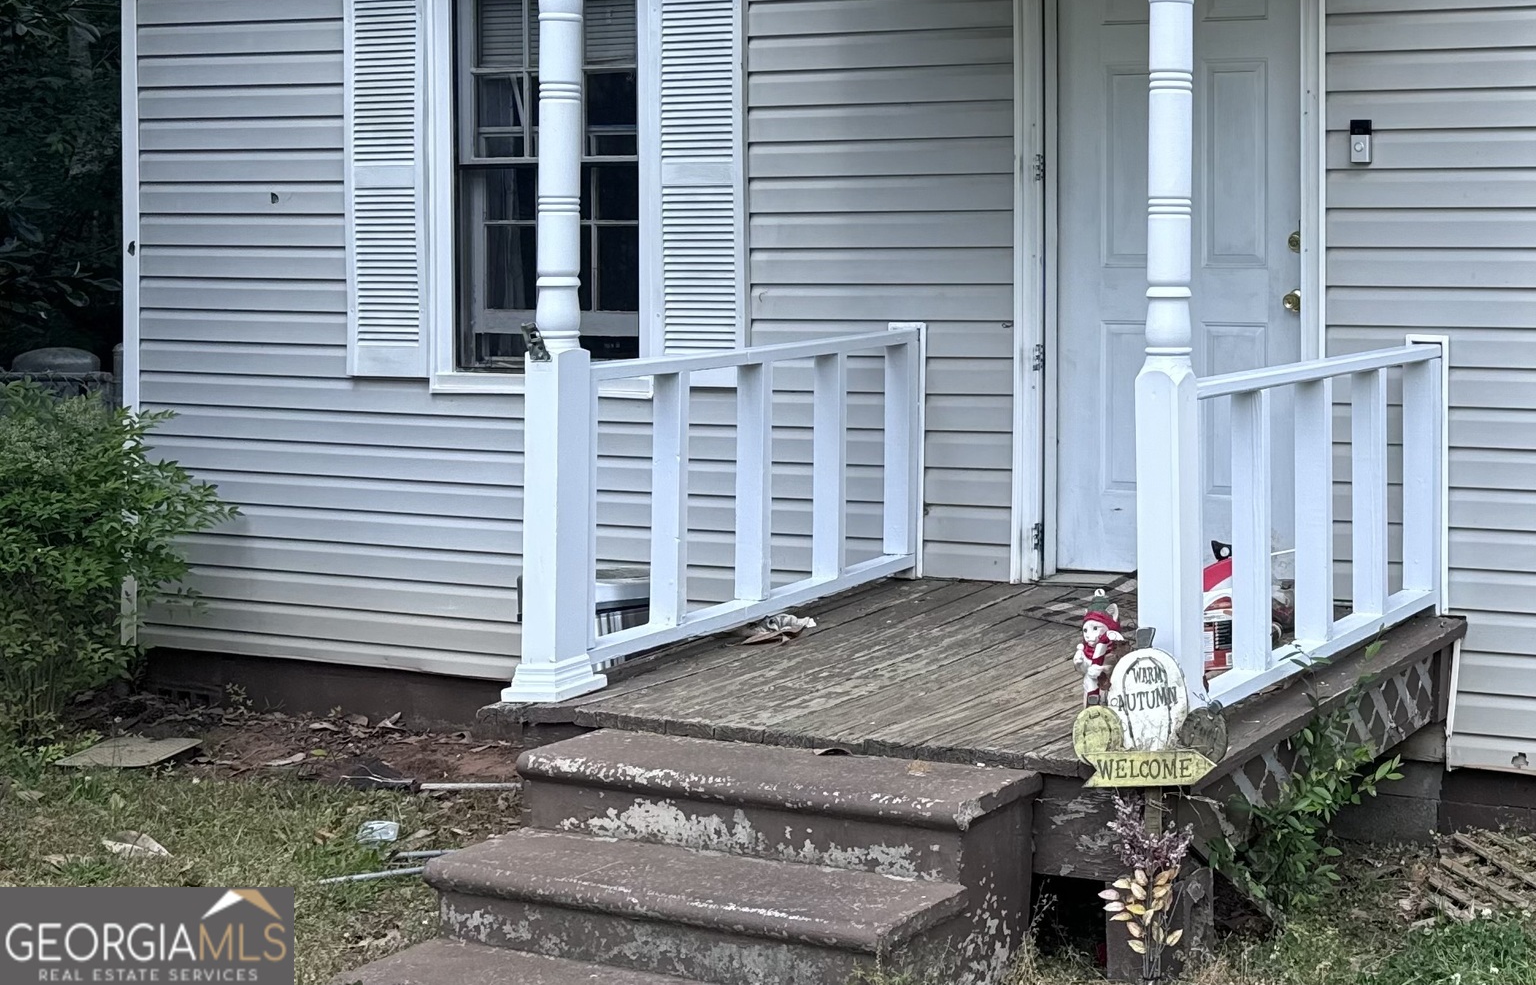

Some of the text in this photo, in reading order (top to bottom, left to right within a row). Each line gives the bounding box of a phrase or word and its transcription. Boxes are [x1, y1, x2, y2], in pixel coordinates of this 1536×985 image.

[1131, 666, 1167, 685] WARM
[1117, 686, 1178, 712] AUTUMN
[1097, 758, 1192, 781] WELCOME
